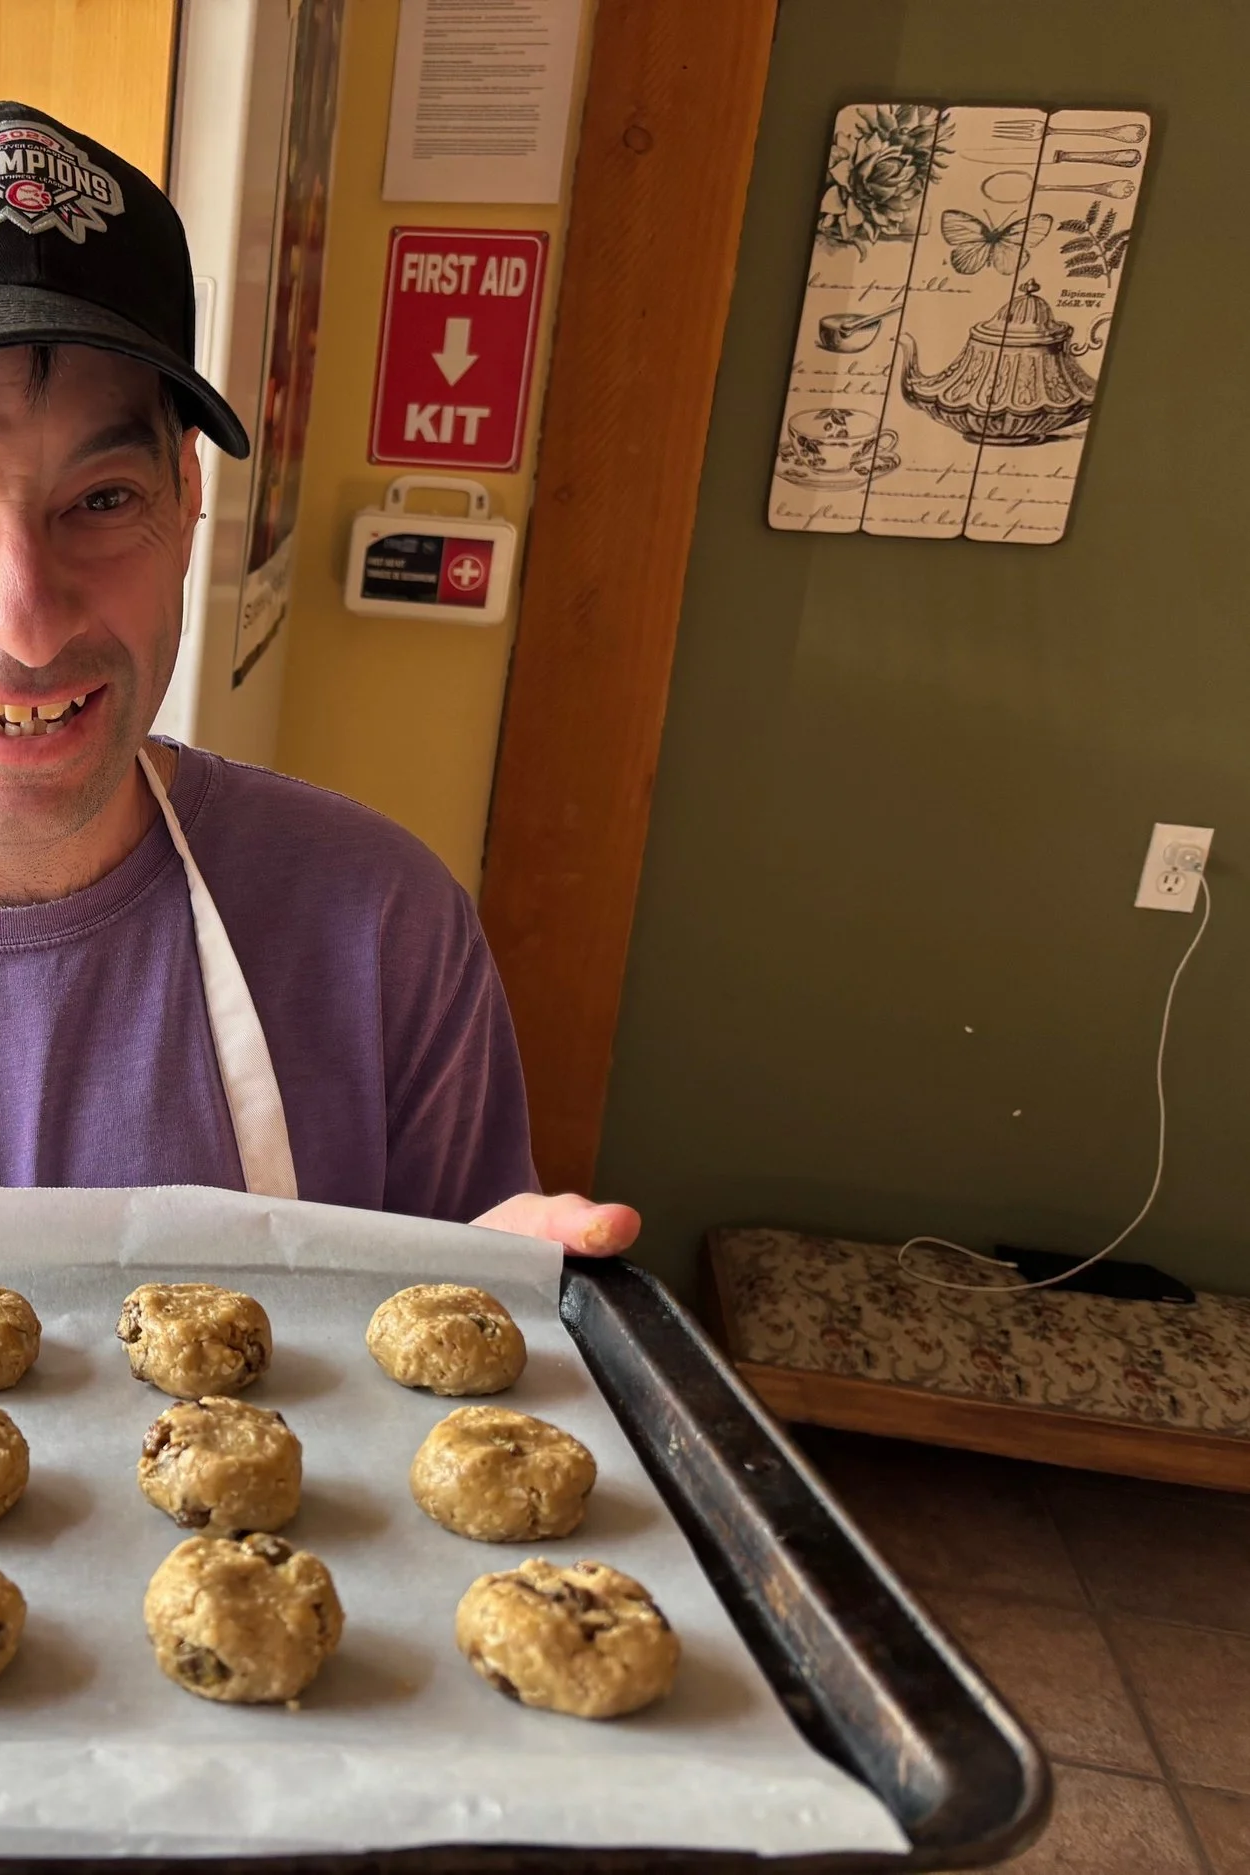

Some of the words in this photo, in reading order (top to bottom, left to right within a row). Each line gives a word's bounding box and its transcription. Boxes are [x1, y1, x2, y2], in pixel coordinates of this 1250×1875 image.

[400, 253, 477, 295] FIRST
[478, 256, 527, 297] AID
[403, 403, 491, 446] KIT
